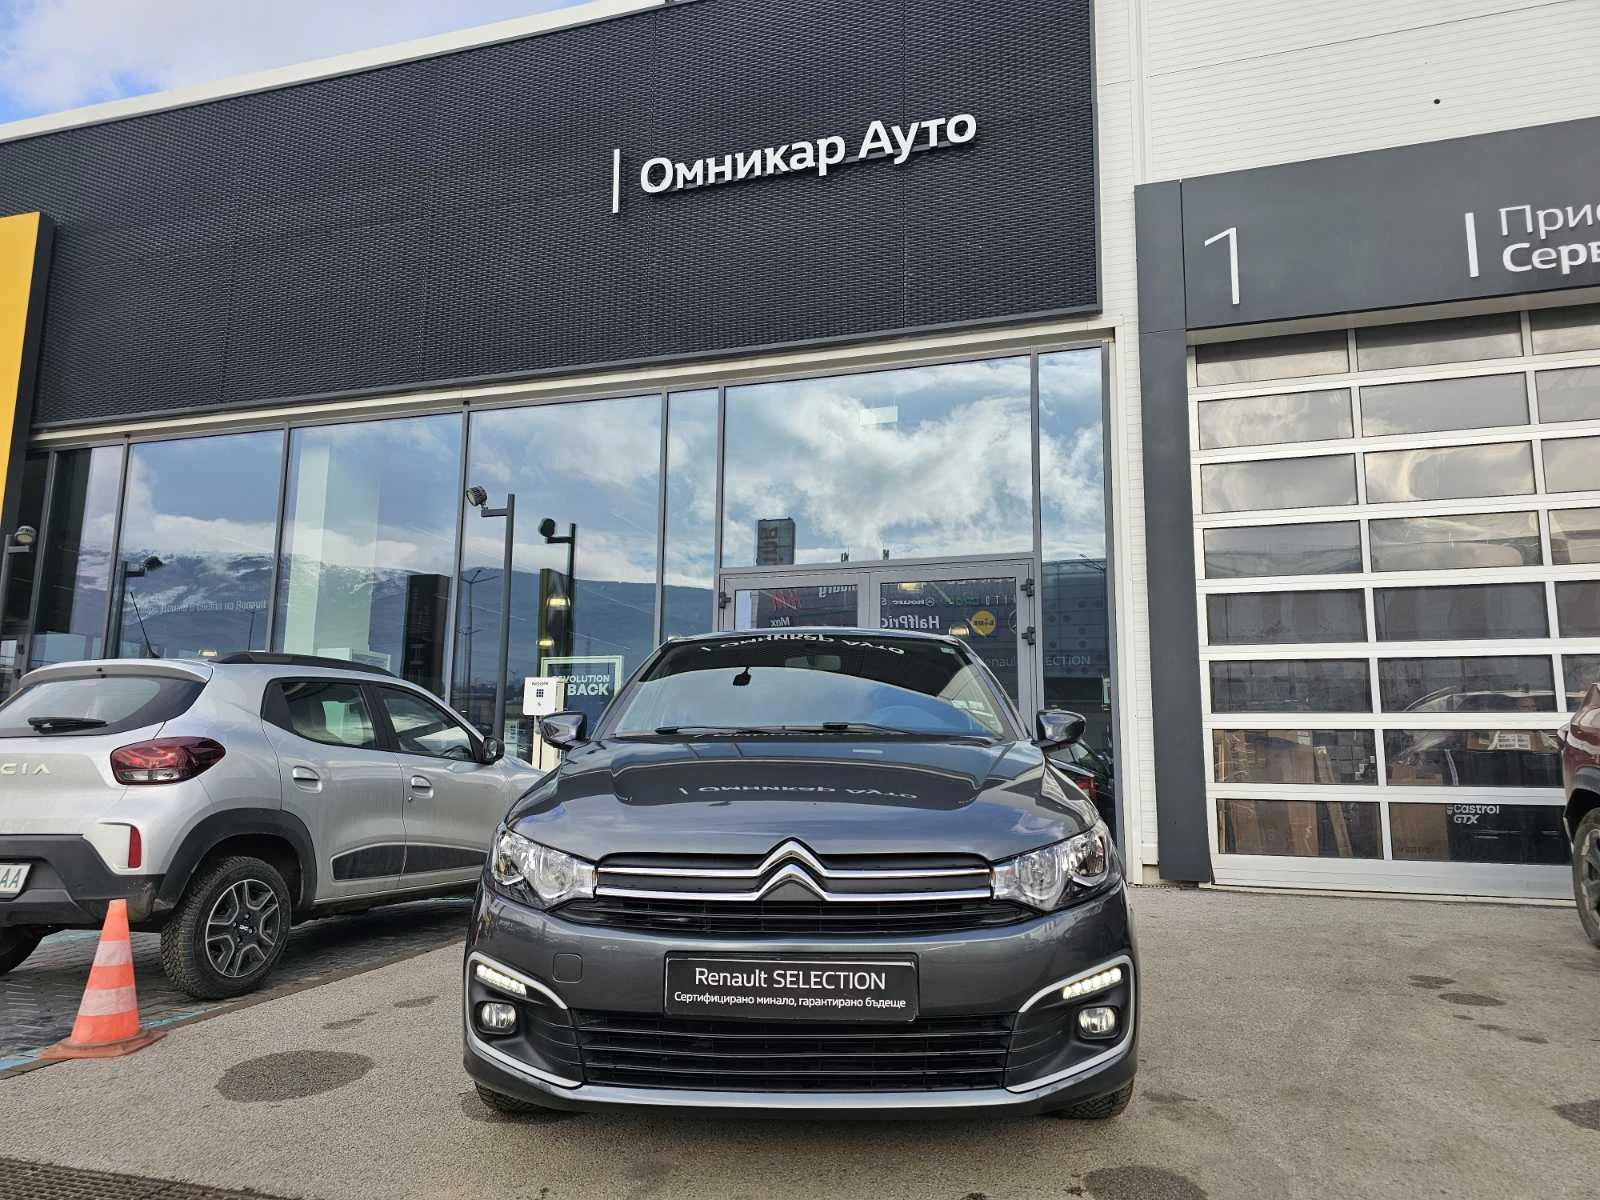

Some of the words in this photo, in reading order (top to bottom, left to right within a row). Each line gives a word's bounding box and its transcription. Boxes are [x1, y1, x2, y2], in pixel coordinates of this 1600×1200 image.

[640, 134, 845, 193] Омникар
[858, 113, 977, 165] Ауто
[1498, 203, 1600, 240] При
[1204, 226, 1240, 305] 1
[567, 683, 609, 696] BACK
[1453, 804, 1500, 815] Castrol
[1453, 814, 1480, 825] GTX
[694, 967, 768, 988] Renault
[772, 970, 887, 990] SELECTION
[674, 991, 755, 1006] Сертифицирано
[756, 996, 797, 1008] минало,
[798, 997, 864, 1009] гарантирано
[865, 996, 907, 1009] бъдеще
